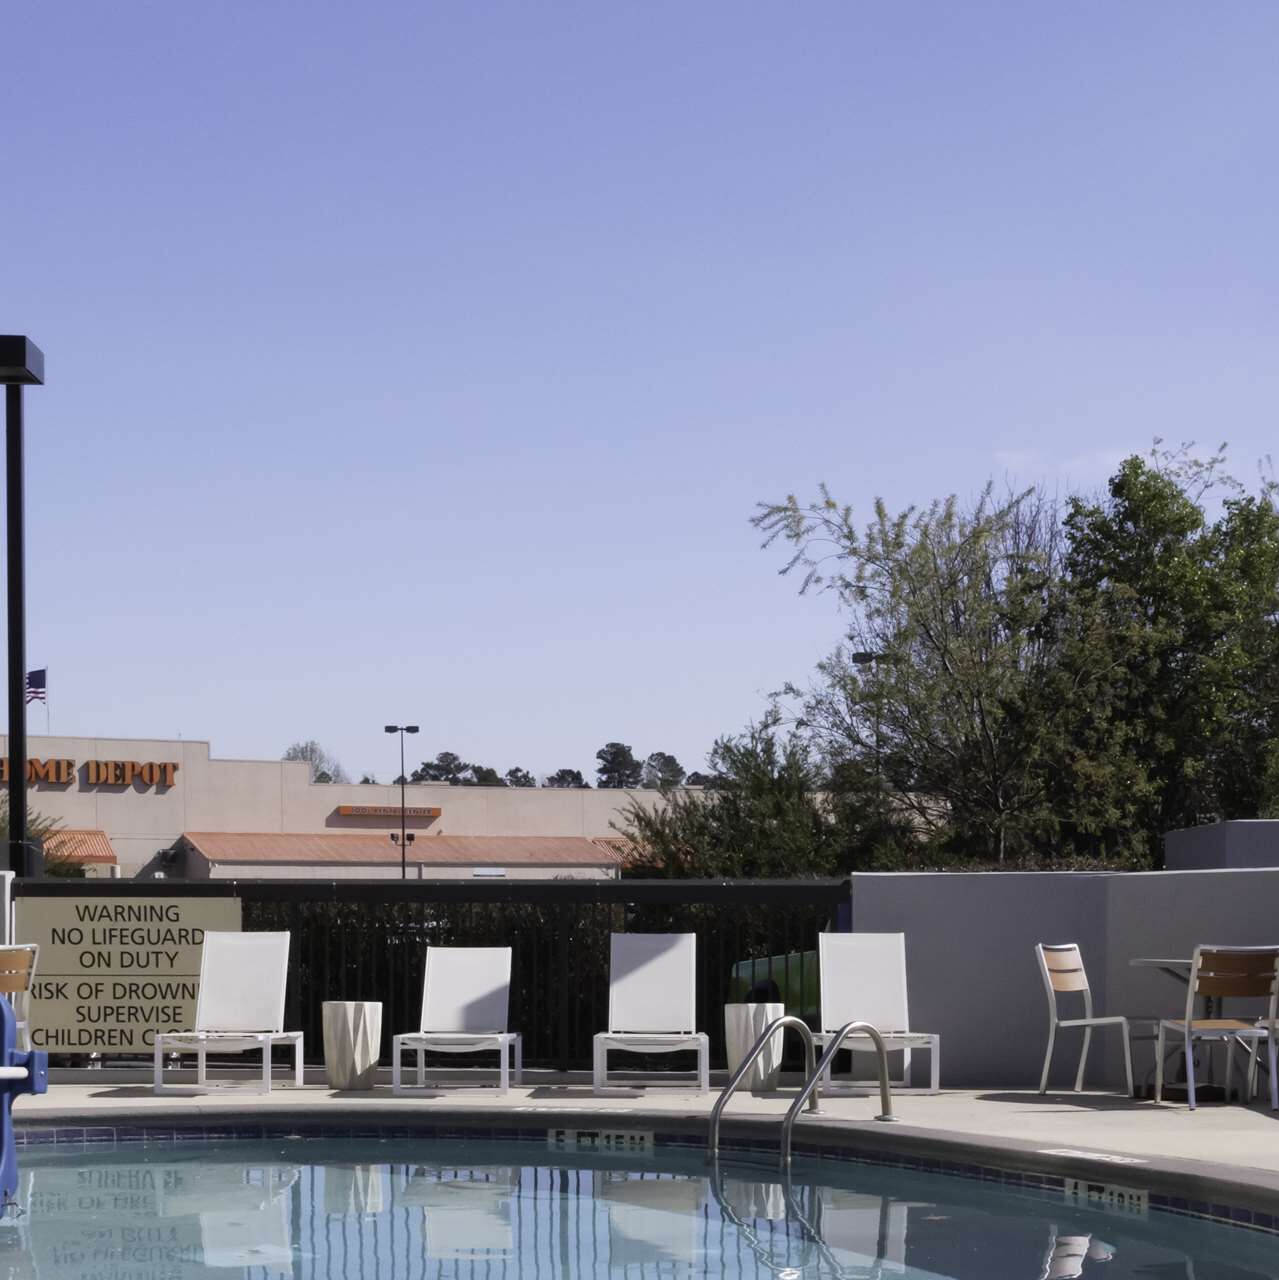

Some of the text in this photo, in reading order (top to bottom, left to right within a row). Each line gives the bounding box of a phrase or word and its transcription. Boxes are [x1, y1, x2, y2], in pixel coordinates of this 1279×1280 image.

[86, 760, 179, 787] DEPOT
[75, 905, 180, 922] WARNING
[51, 928, 205, 945] NO LIFEGUARD
[79, 951, 180, 969] ON DUTY
[77, 982, 105, 1000] OF
[113, 982, 200, 1000] DROWN
[76, 1005, 183, 1023] SUPERVISE
[31, 1028, 133, 1046] CHILDREN
